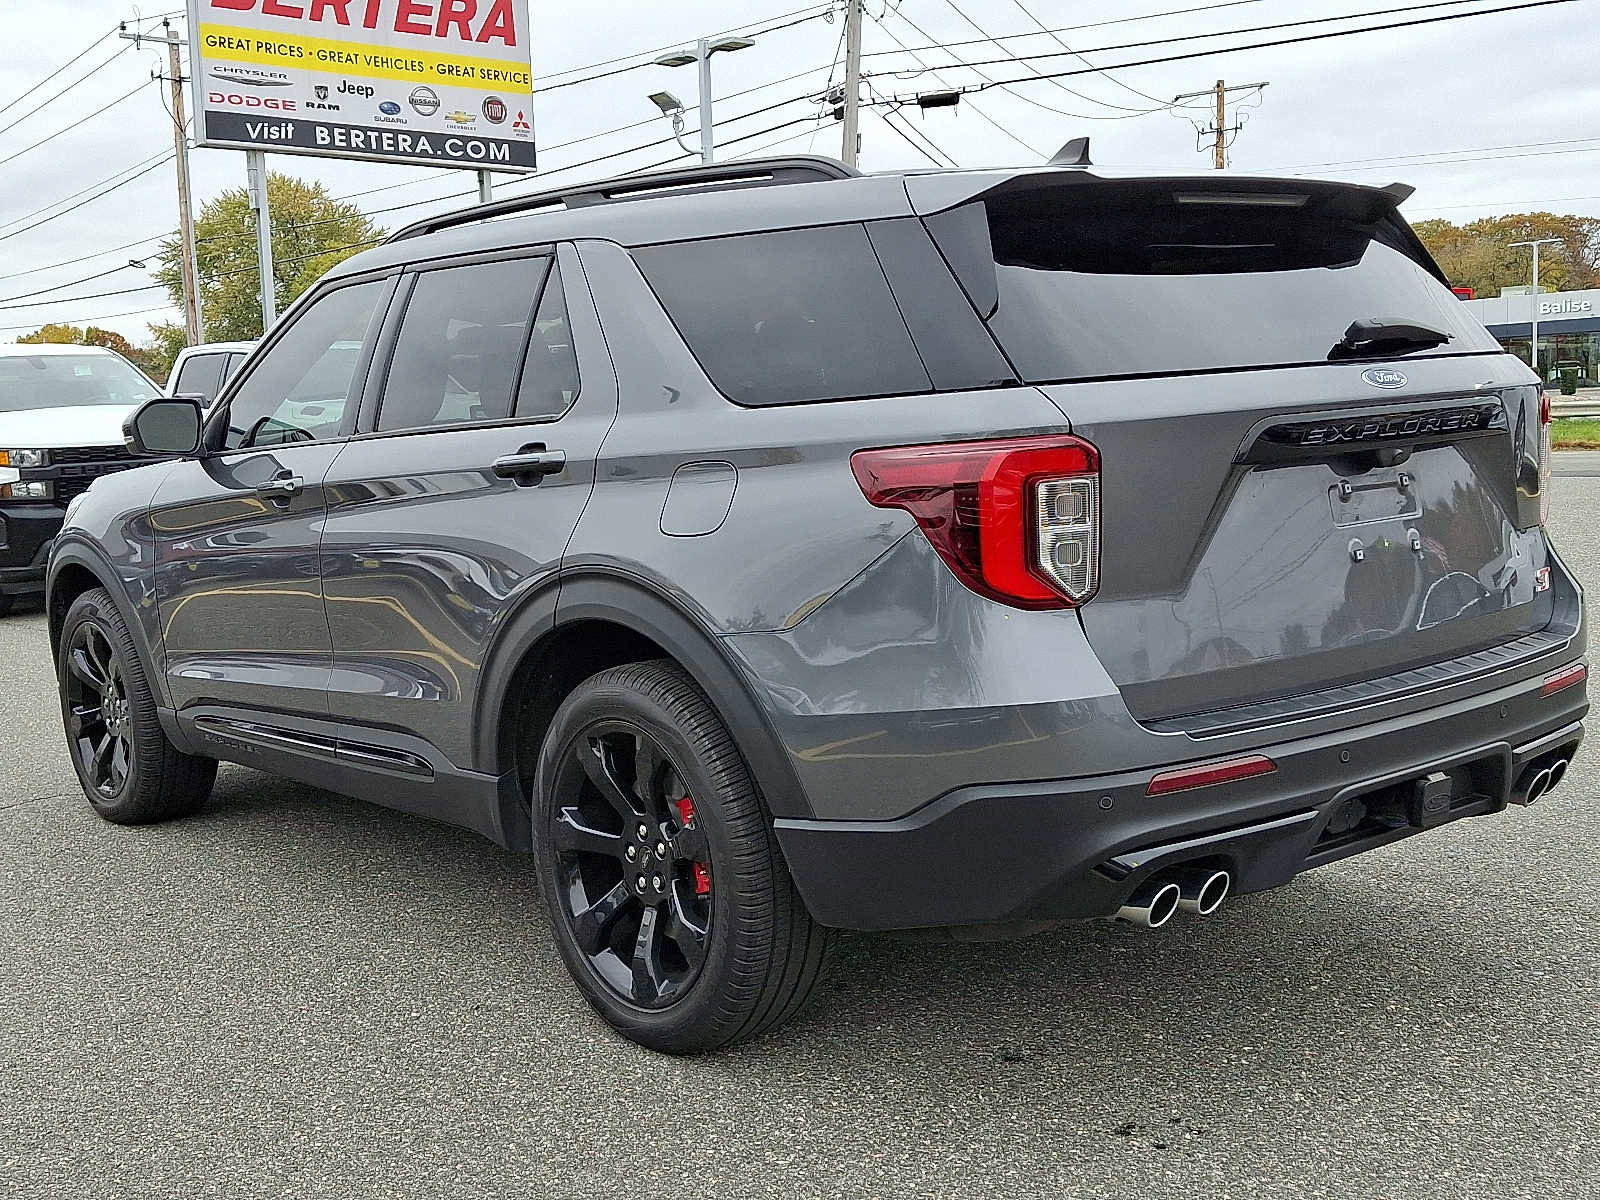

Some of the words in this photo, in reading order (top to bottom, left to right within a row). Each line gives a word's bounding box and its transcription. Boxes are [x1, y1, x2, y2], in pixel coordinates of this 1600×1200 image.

[210, 0, 517, 47] RTERA
[205, 34, 251, 53] GREAT
[256, 40, 304, 60] PRICES
[316, 49, 360, 67] GREAT
[364, 54, 424, 74] VEHICLES
[436, 63, 475, 80] GREAT
[479, 67, 529, 86] SERVICE
[213, 65, 288, 80] CHRYSLER
[336, 79, 375, 99] Jeep
[208, 92, 297, 112] DODGE
[305, 101, 341, 111] RAM
[411, 97, 438, 106] NISSAN
[488, 103, 502, 118] FIAT
[374, 115, 408, 125] SUBARU
[245, 121, 295, 141] Visit
[315, 125, 511, 162] BERTERA.COM
[1539, 299, 1592, 315] Balise
[1375, 370, 1402, 383] Ford
[1300, 412, 1481, 445] EXPLORER
